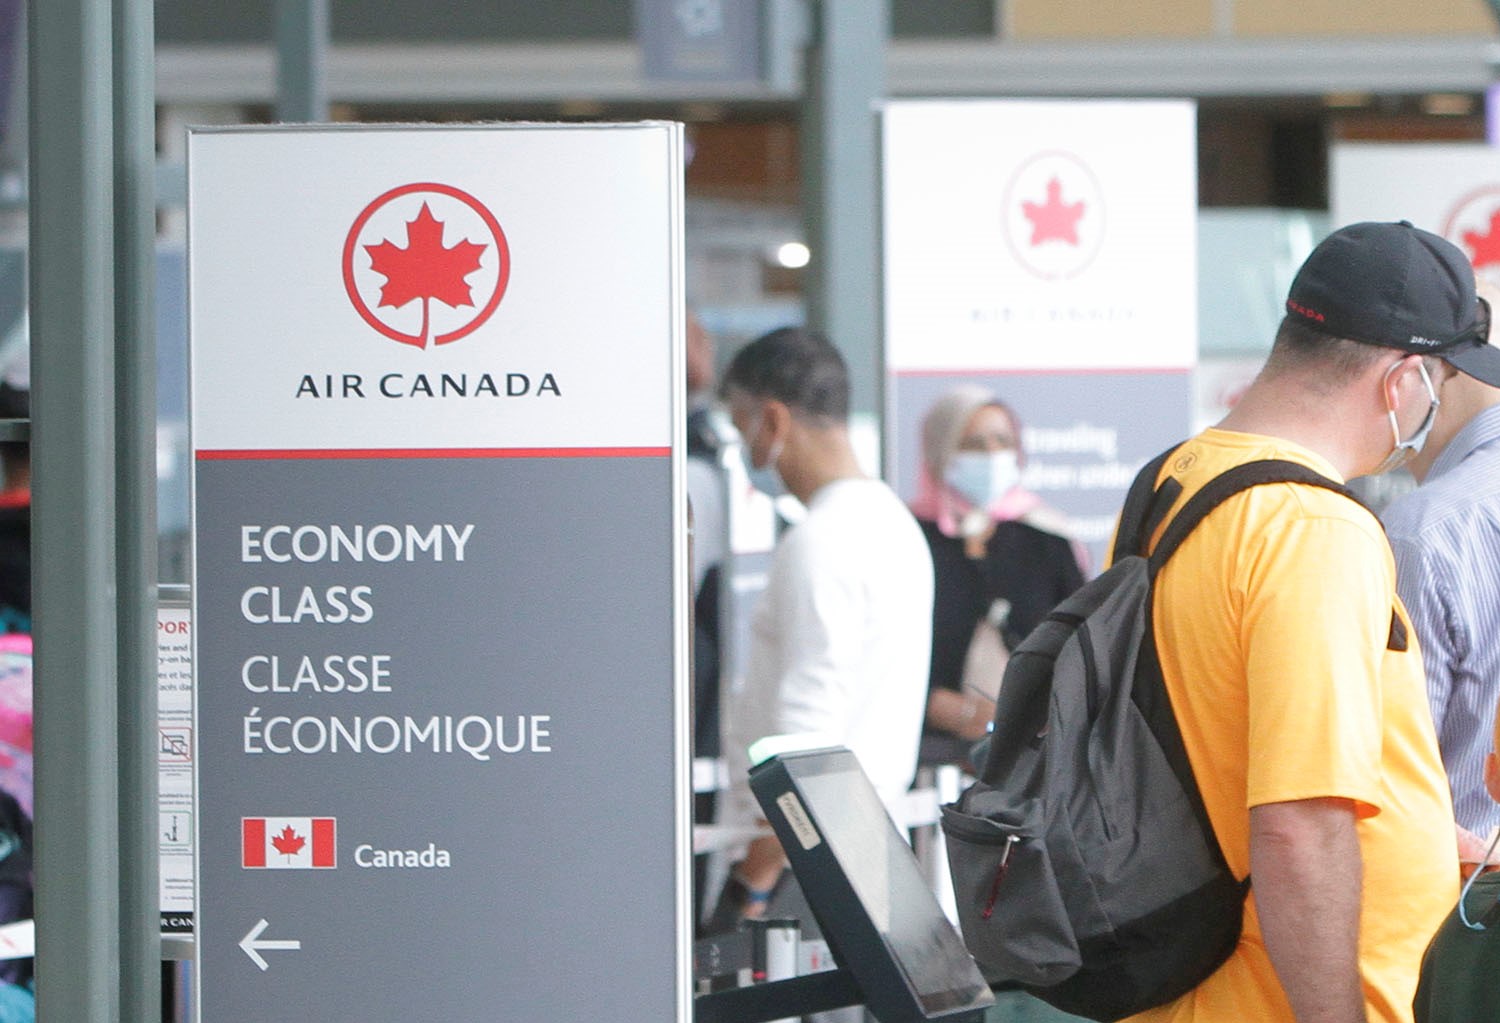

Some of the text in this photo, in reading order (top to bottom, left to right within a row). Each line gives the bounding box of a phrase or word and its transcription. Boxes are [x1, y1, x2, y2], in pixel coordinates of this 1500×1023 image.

[296, 373, 562, 399] AIR CANADA
[241, 524, 475, 563] ECONOMY
[241, 585, 374, 624] CLASS
[241, 655, 392, 692] CLASSE
[243, 706, 552, 761] ÉCONOMIQUE
[354, 842, 451, 868] Canada
